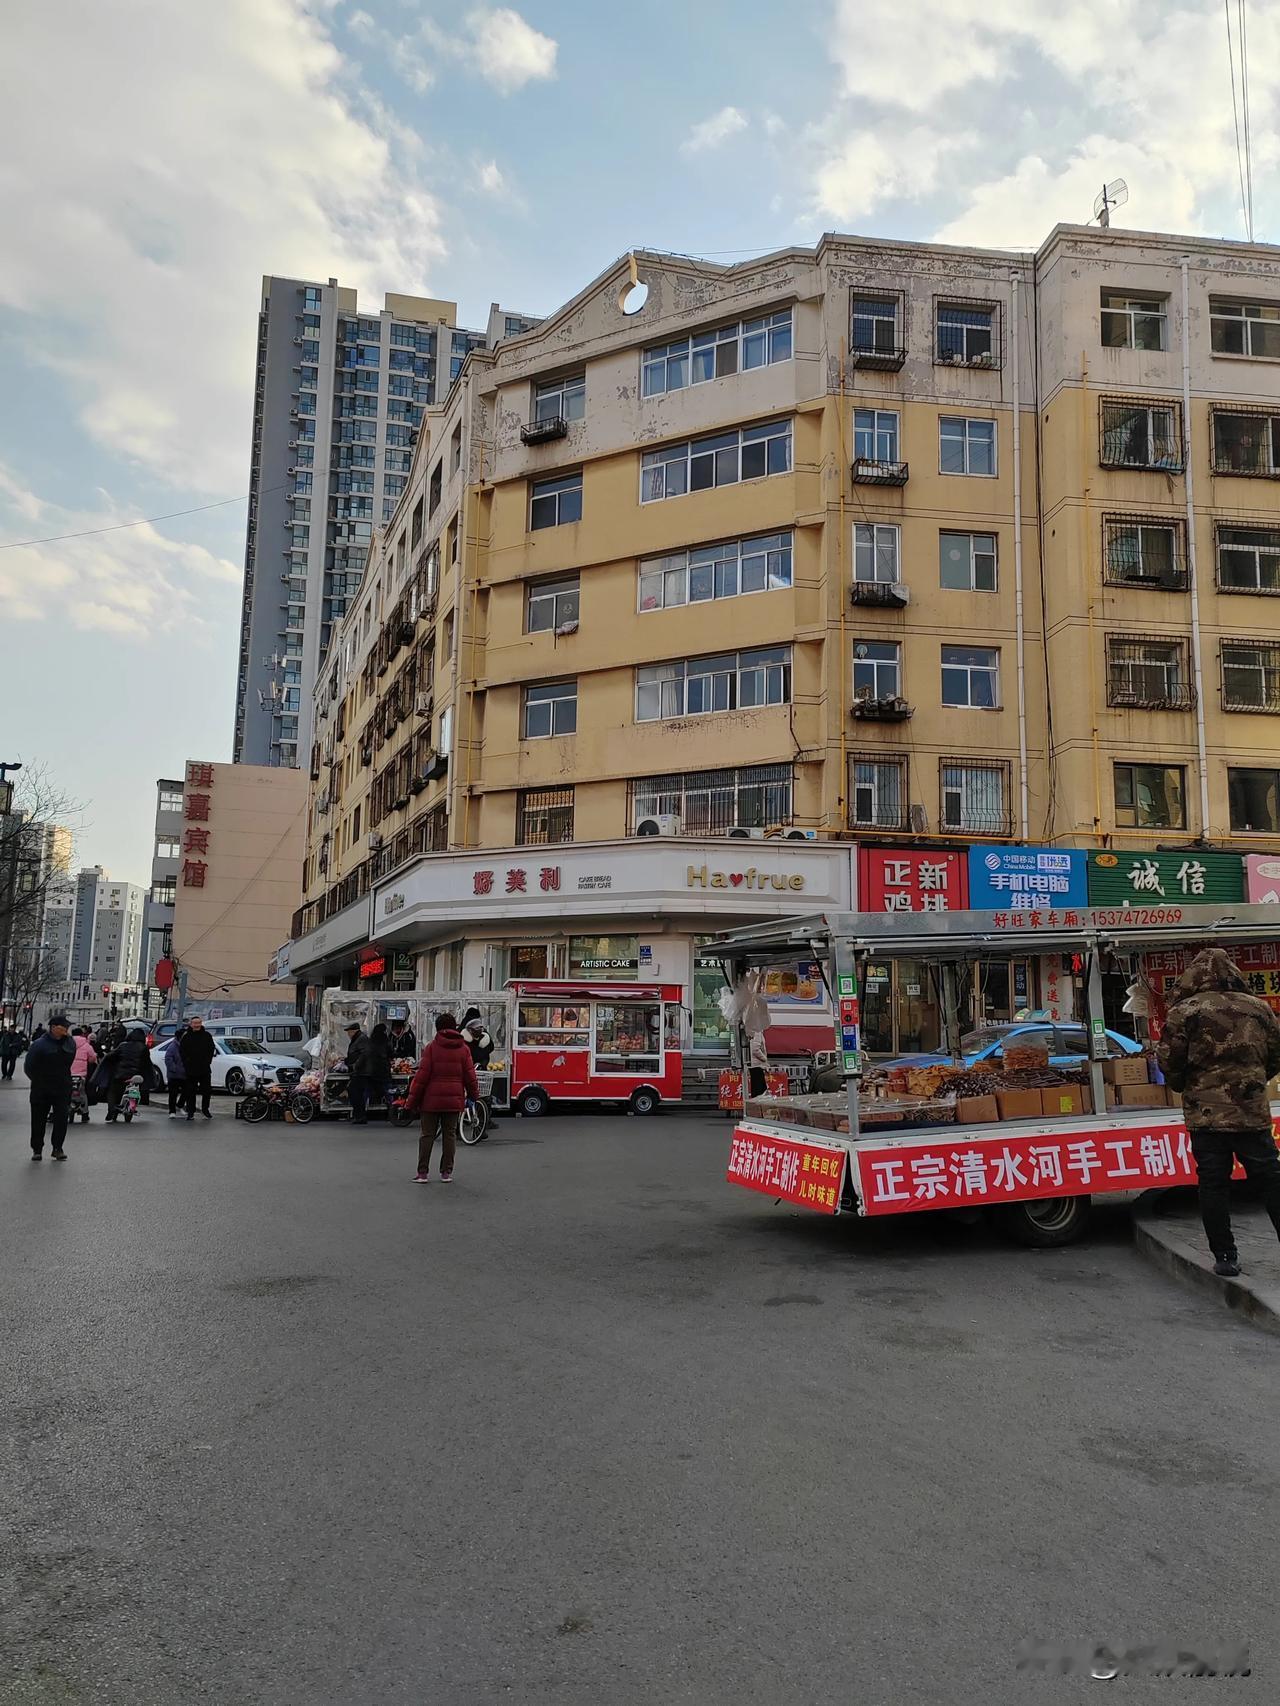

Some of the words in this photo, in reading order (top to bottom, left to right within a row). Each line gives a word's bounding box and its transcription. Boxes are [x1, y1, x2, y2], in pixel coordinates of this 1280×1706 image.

[182, 763, 214, 888] 琪嘉宾馆
[1003, 854, 1036, 864] 中国移动
[472, 866, 561, 895] 好芙利
[883, 859, 948, 890] 正新
[989, 873, 1069, 893] 手机电脑
[1126, 859, 1207, 896] 诚信
[1010, 892, 1051, 909] 维修
[580, 960, 610, 968] ARTISTIC
[611, 959, 630, 968] CAKE
[728, 1139, 800, 1194] 正宗清水河手工制作
[802, 1152, 840, 1179] 童年回忆
[798, 1181, 836, 1208] 儿时味道
